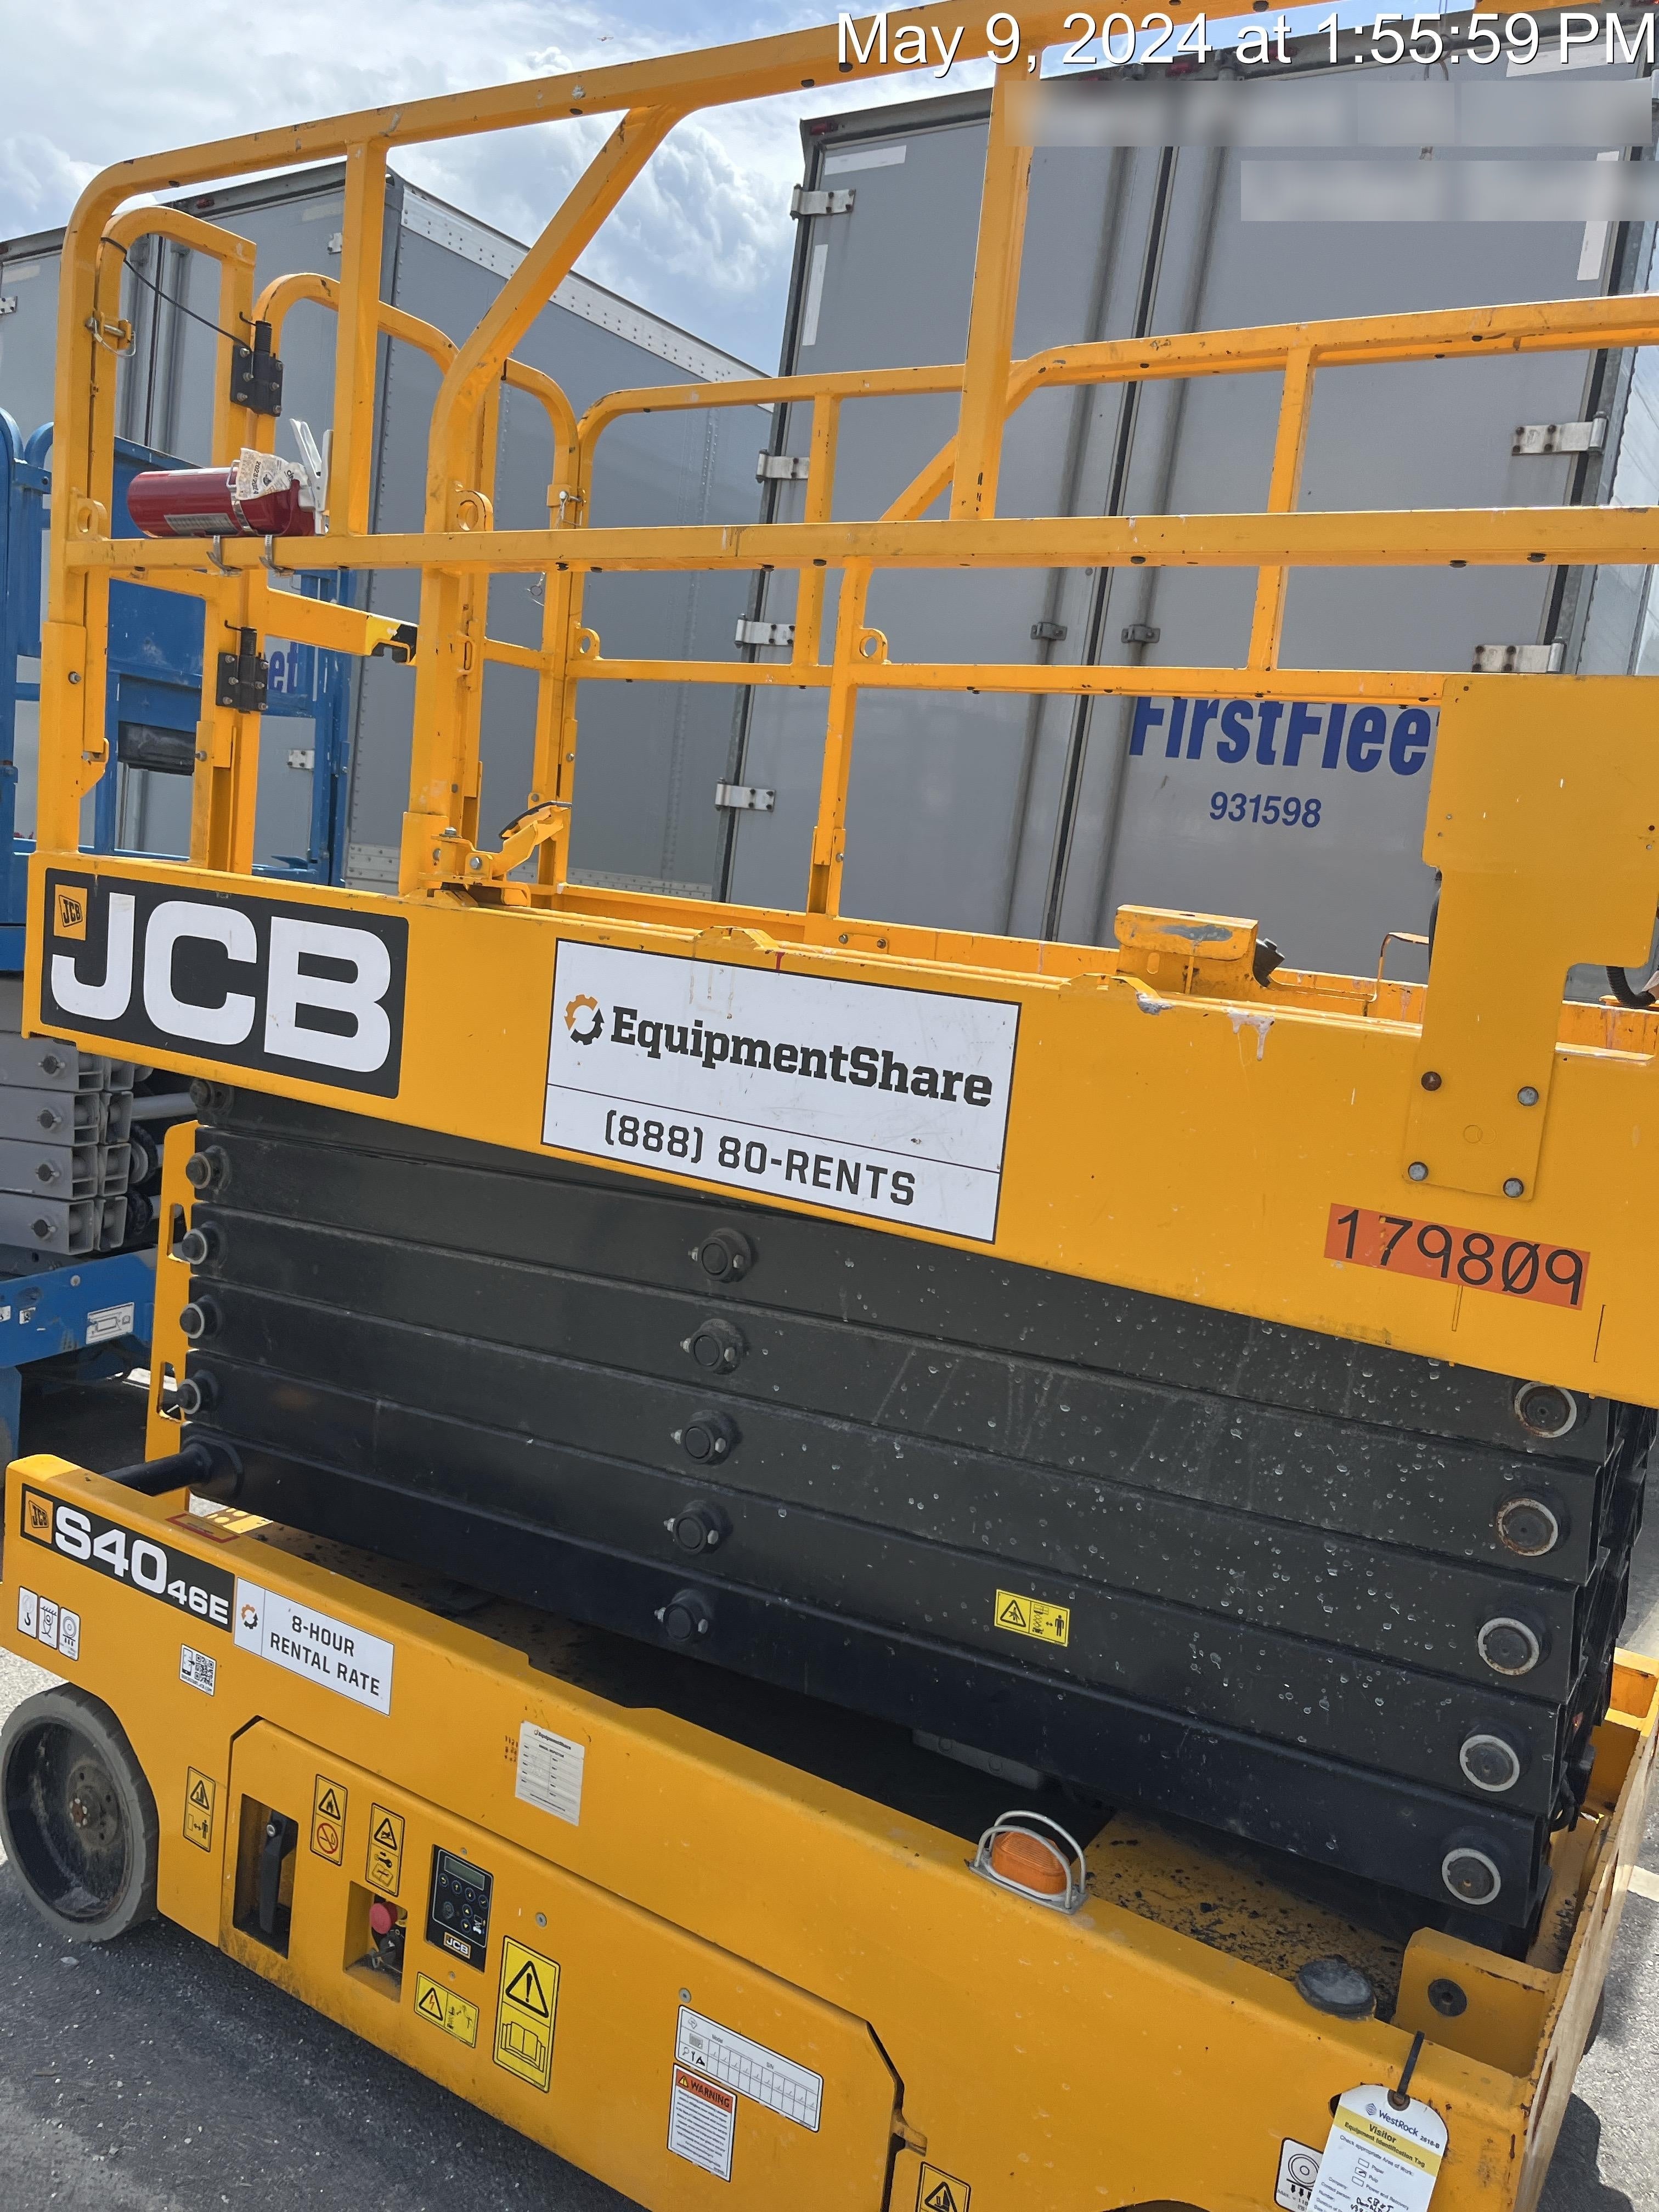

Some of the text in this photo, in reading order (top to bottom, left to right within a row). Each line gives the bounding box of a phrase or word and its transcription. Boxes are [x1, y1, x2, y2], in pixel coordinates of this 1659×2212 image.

[1129, 696, 1440, 776] FirstFlee
[1209, 791, 1322, 828] 931598
[62, 899, 81, 924] JCB
[51, 893, 392, 1073] JCB
[611, 1006, 993, 1107] EquipmentShare
[605, 1109, 916, 1206] (888) 80-RENTS
[32, 1504, 48, 1526] JCB
[291, 1615, 355, 1657] 8-HOUR
[270, 1632, 380, 1696] RENTAL RATE
[446, 1938, 468, 1955] JCB
[691, 2079, 730, 2108] WARNING
[1340, 2135, 1355, 2146] Check
[1369, 2123, 1397, 2143] Visitor
[1379, 2109, 1419, 2137] WestRock
[1344, 2121, 1426, 2168] Equipment Identification Tag
